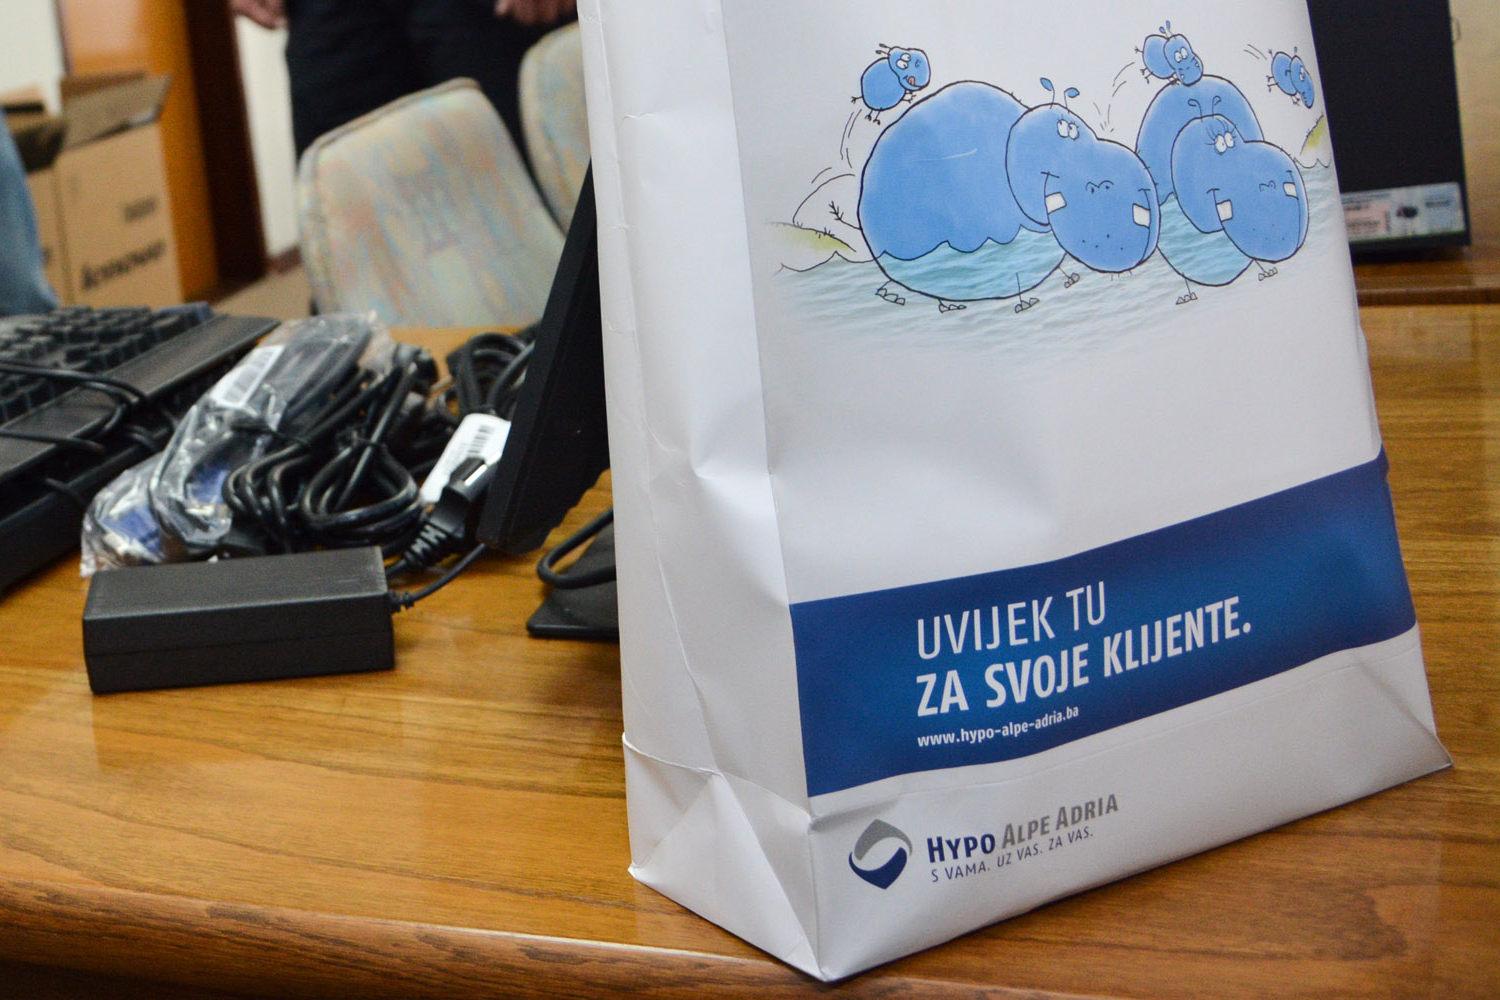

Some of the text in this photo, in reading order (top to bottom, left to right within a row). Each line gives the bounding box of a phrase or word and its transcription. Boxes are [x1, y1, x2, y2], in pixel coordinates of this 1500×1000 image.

[917, 581, 1106, 660] UVIJEK TU
[916, 595, 1252, 717] ZA SVOJE KLIJENTE.
[917, 705, 1080, 748] www.hypo-alpe-adria.ba
[930, 826, 1094, 884] S VAMA. UZ VAS. ZA VAS.
